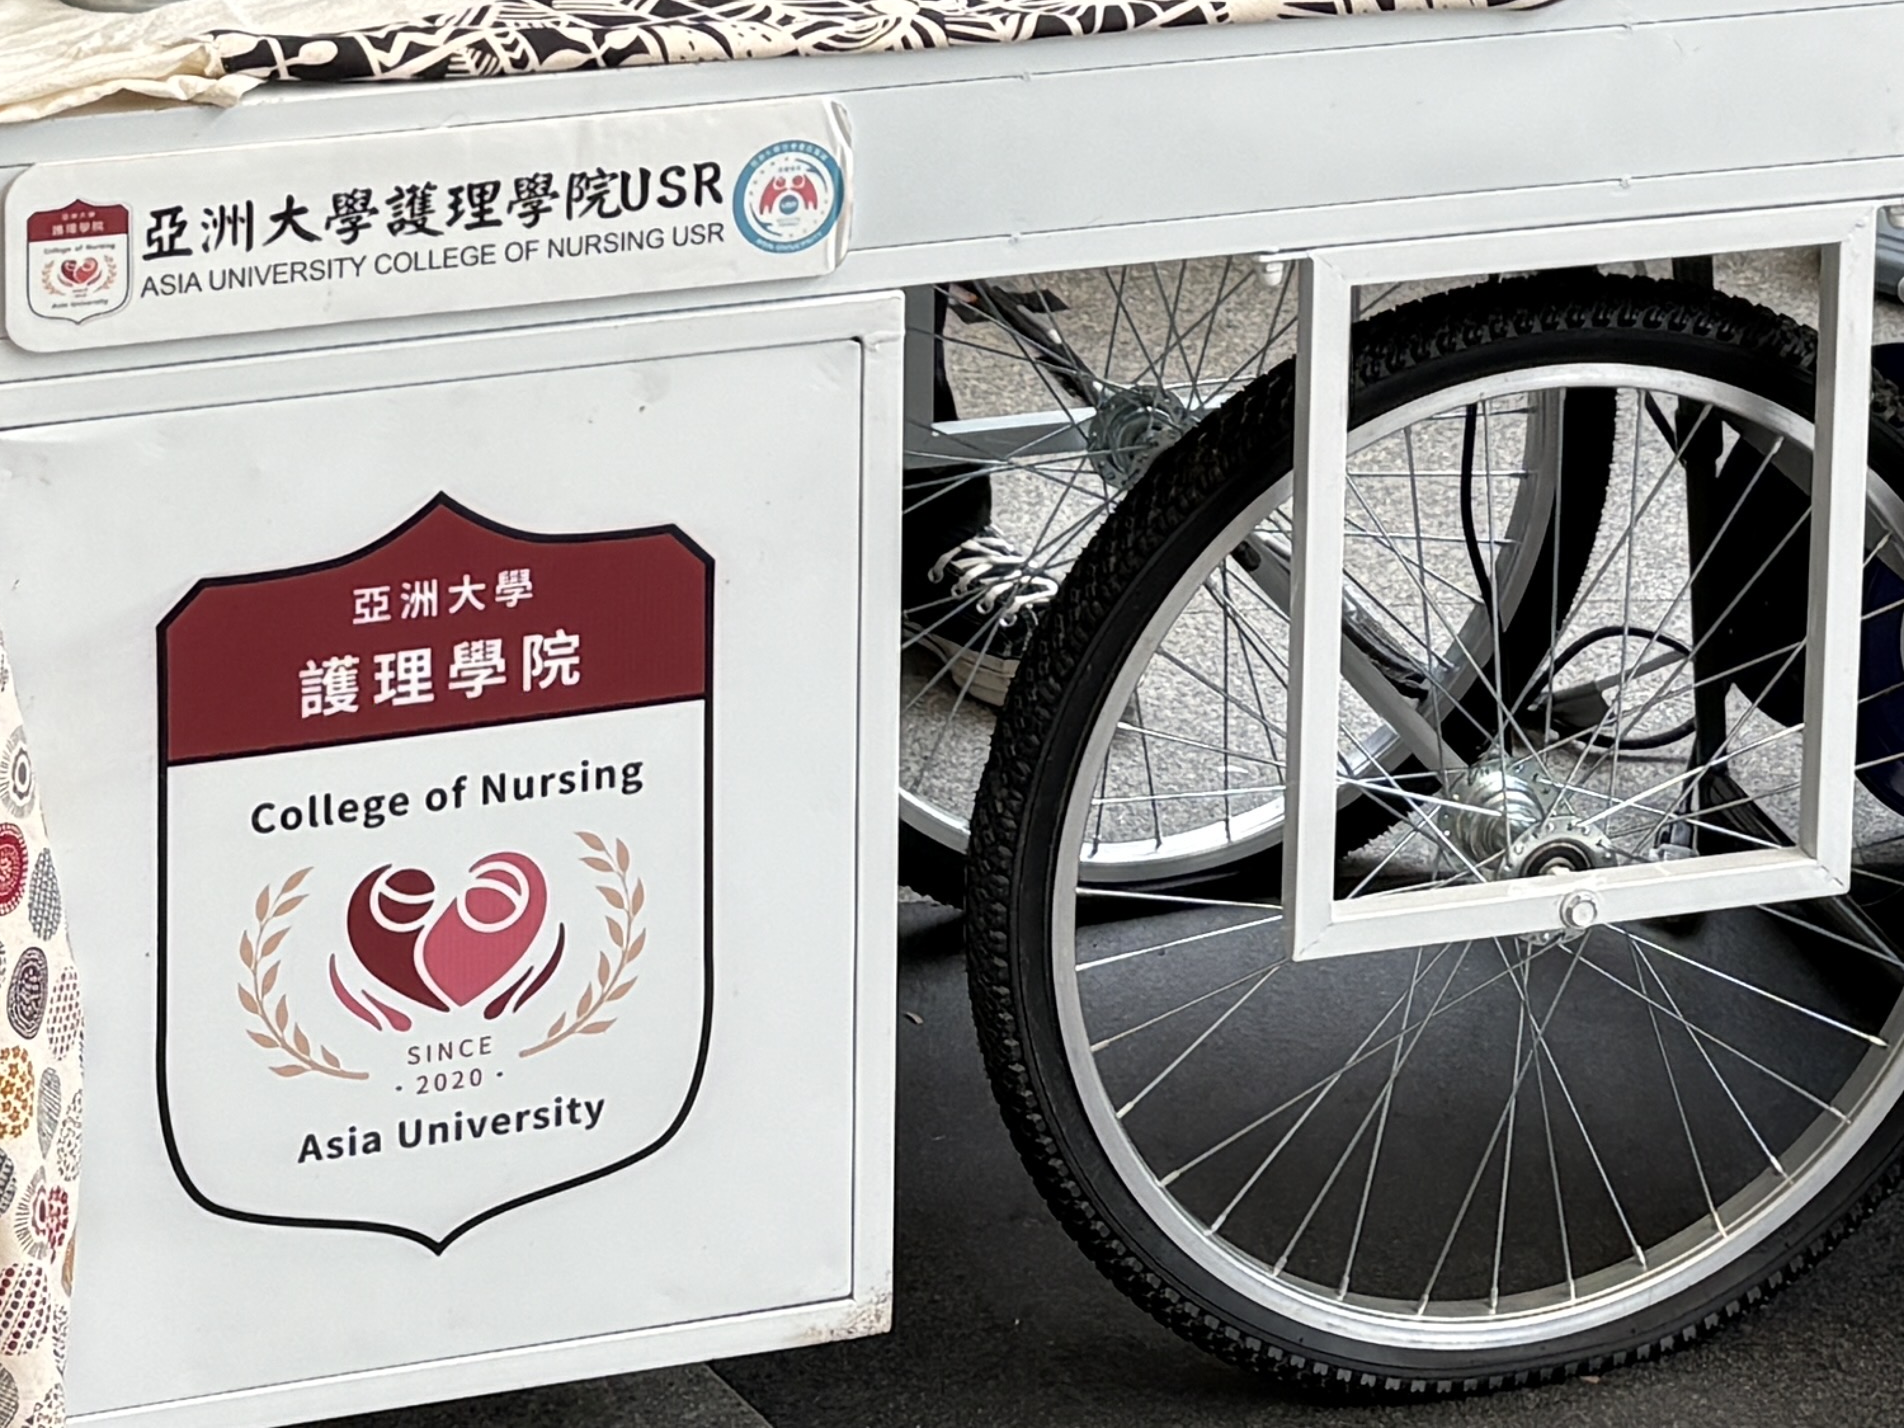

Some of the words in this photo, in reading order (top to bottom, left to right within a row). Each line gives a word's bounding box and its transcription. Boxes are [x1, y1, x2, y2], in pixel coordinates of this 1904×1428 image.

[142, 161, 723, 261] 亞洲大學護理學院USR
[141, 272, 202, 297] ASIA
[208, 255, 367, 291] UNIVERSITY
[374, 244, 497, 275] COLLEGE
[504, 239, 540, 263] OF
[548, 228, 664, 260] NURSING
[672, 222, 725, 247] USR
[352, 568, 534, 626] 亞洲大學
[299, 628, 582, 719] 護理學院
[251, 791, 410, 834] College
[425, 776, 467, 811] of
[482, 758, 644, 806] Nursing
[407, 1034, 494, 1065] SINCE
[416, 1067, 484, 1095] 2020
[297, 1127, 382, 1164] Asia
[398, 1096, 606, 1149] University
